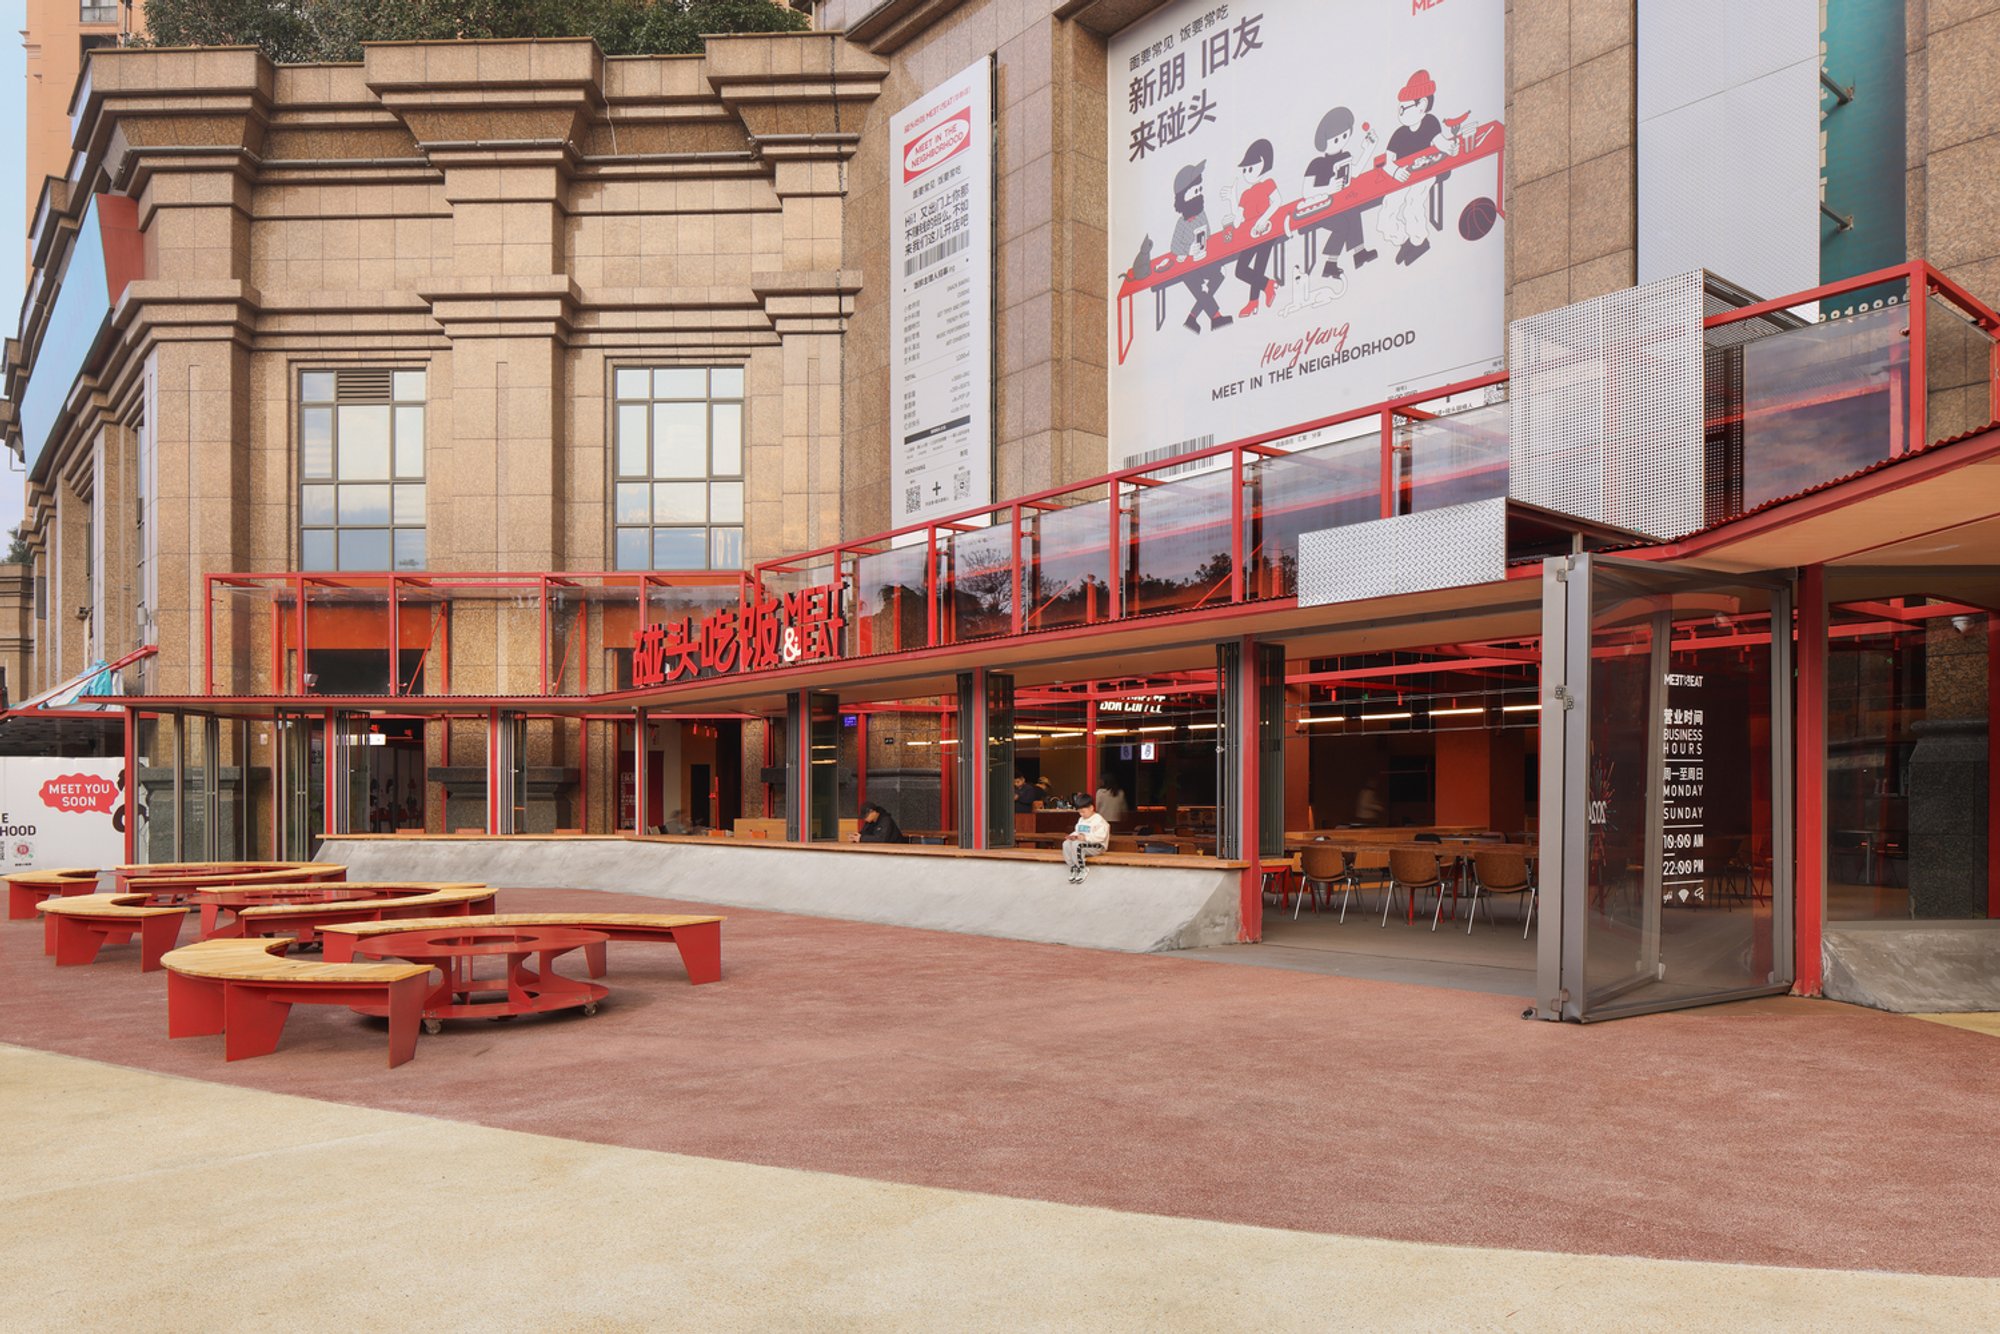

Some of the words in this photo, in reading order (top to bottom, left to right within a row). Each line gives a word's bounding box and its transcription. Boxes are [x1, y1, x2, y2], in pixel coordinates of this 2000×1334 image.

[1129, 34, 1175, 72] 面要常见
[1180, 4, 1229, 43] 饭要常吃
[1129, 52, 1185, 114] 新朋
[1201, 13, 1264, 78] 旧友
[1129, 88, 1217, 162] 来碰头
[915, 137, 933, 154] MEET
[935, 132, 942, 143] IN
[944, 123, 957, 138] THE
[911, 131, 964, 168] NEIGHBORHOOD
[1212, 380, 1245, 401] MEET
[1250, 375, 1263, 390] IN
[1268, 366, 1293, 385] THE
[1299, 330, 1416, 376] NEIGHBORHOOD
[784, 581, 843, 627] MEET
[633, 592, 779, 686] 碰头吃饭
[1664, 708, 1703, 725] 营业时间
[1664, 729, 1703, 741] BUSINESS
[1663, 742, 1702, 755] HOURS
[1663, 767, 1703, 781] 周一至周日
[49, 784, 82, 794] MEET
[85, 784, 110, 794] YOU
[1663, 785, 1703, 797] MONDAY
[62, 796, 97, 807] SOON
[1663, 807, 1703, 819] SUNDAY
[1663, 834, 1692, 849] 10:00
[1693, 834, 1704, 848] AM
[1663, 861, 1692, 876] 22:00
[1693, 860, 1704, 873] PM
